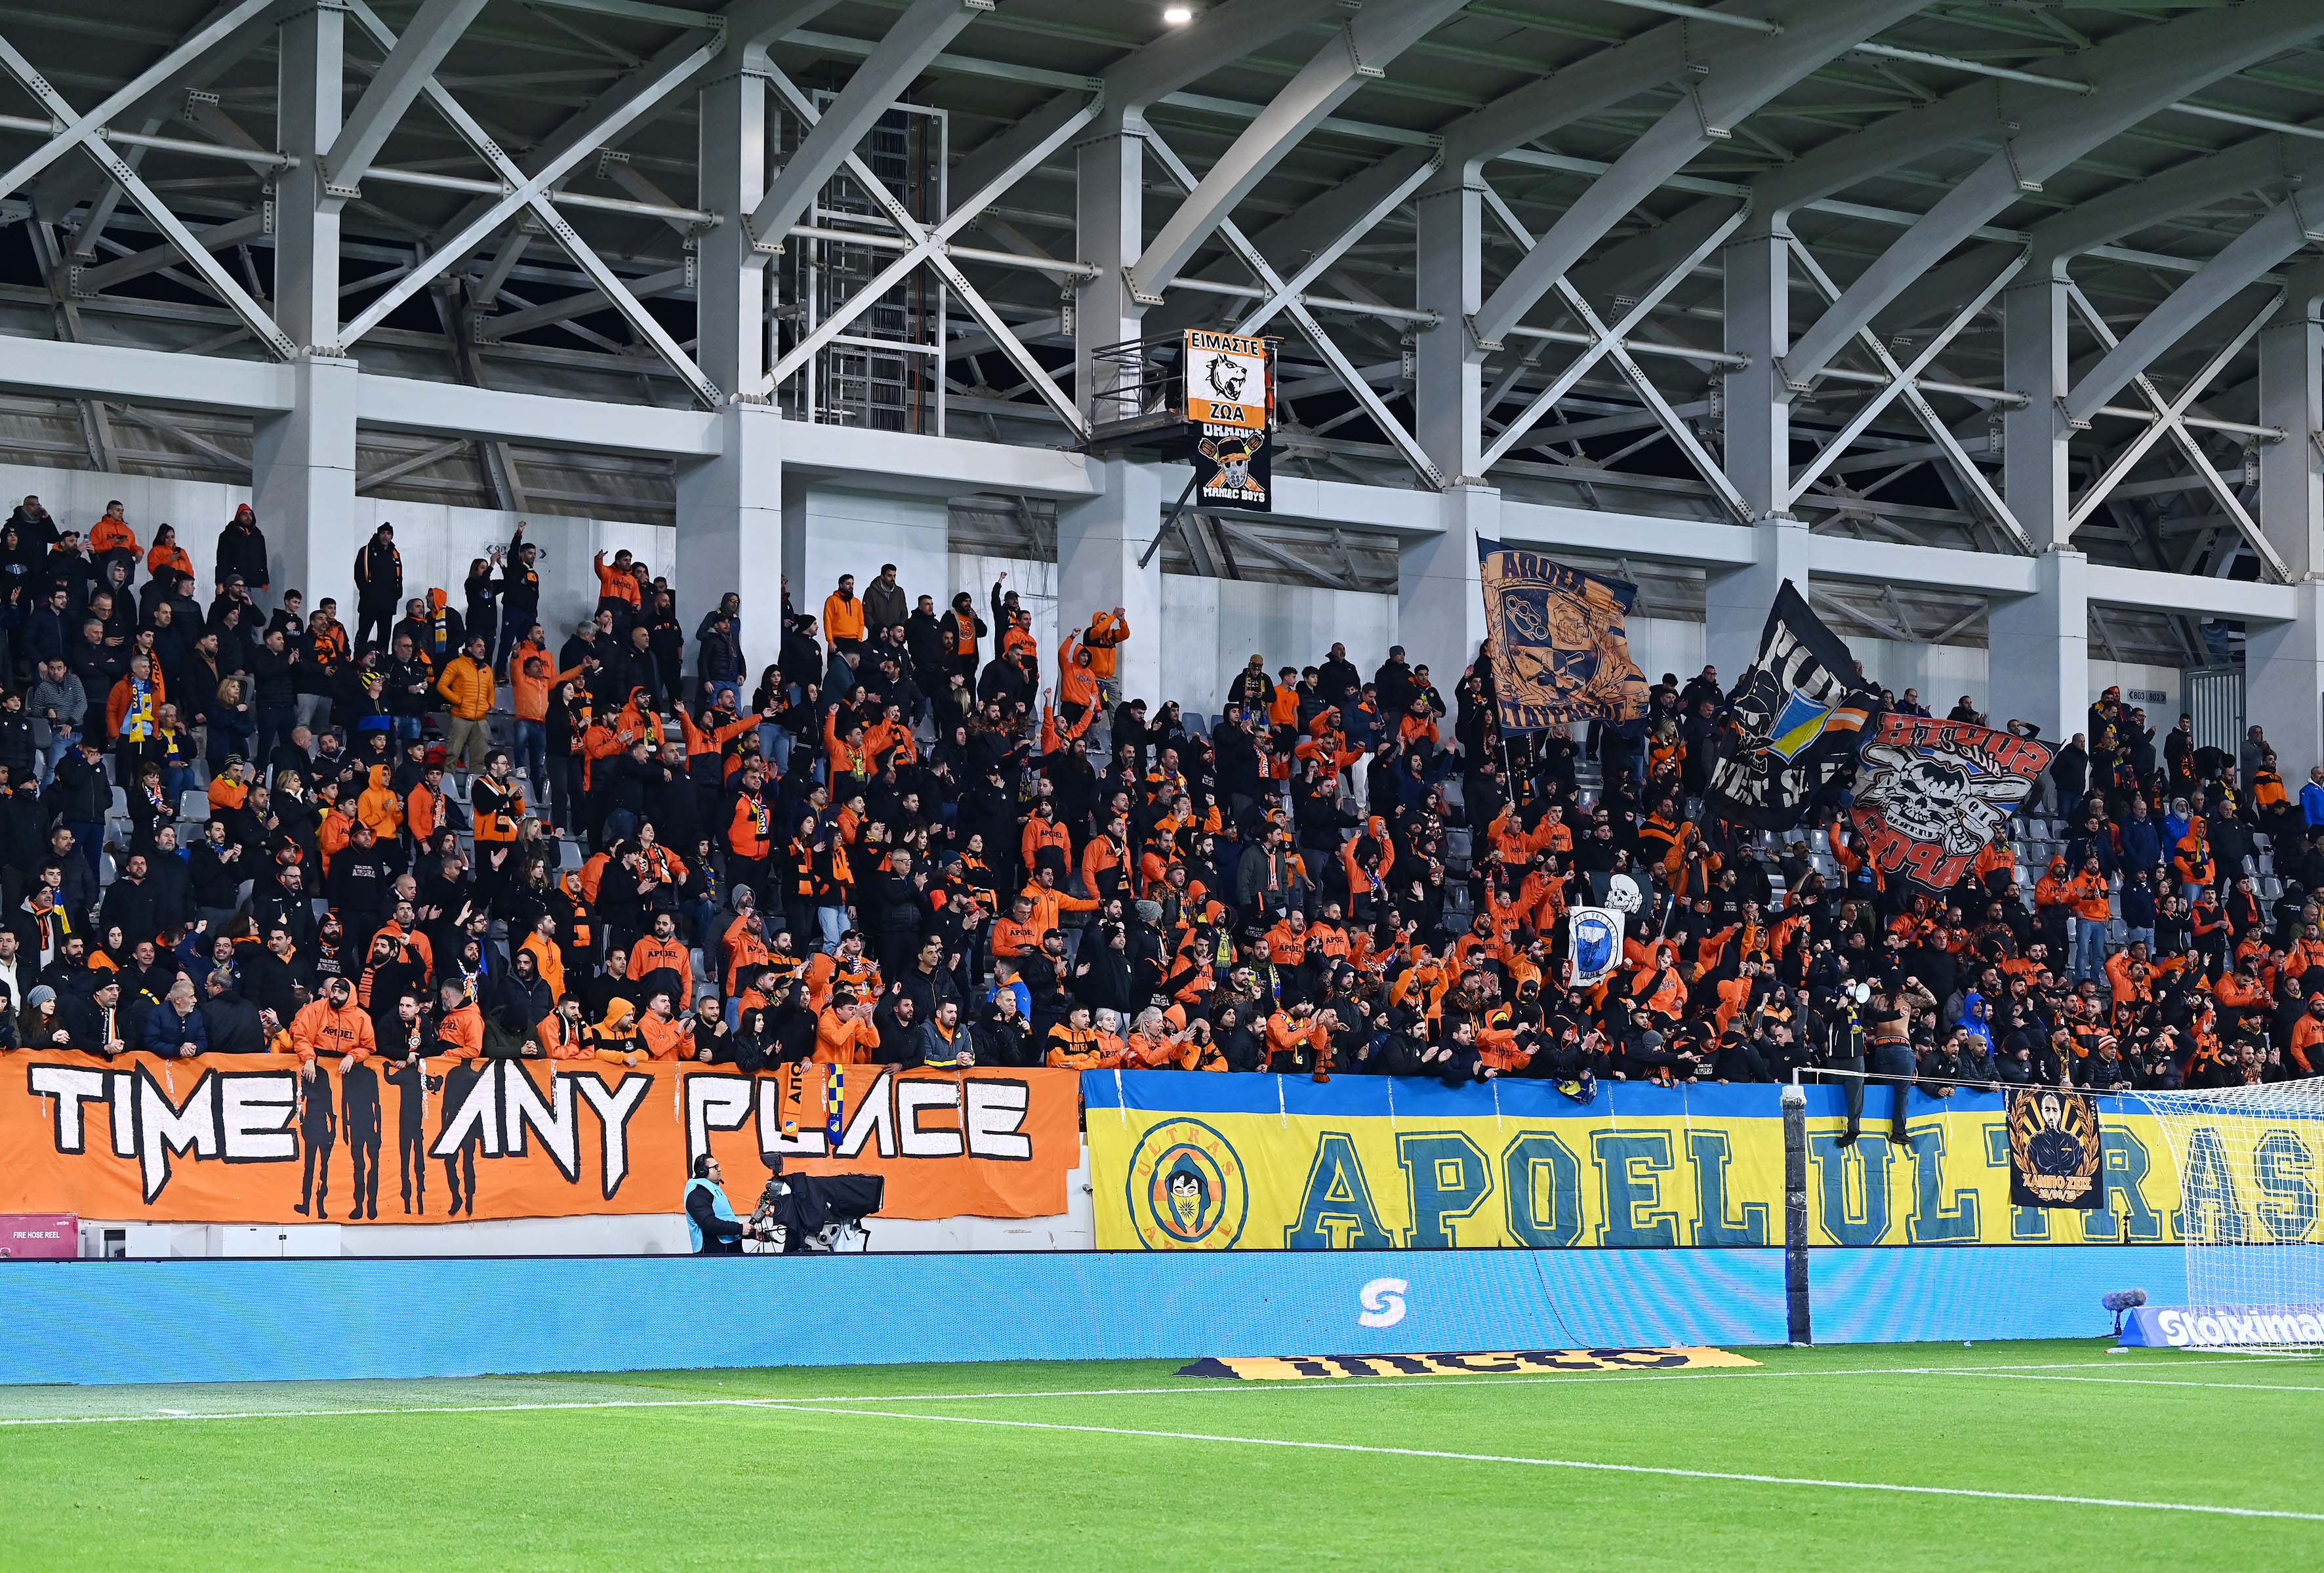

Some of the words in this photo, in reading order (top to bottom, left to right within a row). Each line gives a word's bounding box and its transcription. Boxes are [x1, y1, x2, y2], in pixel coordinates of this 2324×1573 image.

[1191, 331, 1259, 356] ΕΙΜΑΣΤΕ
[1210, 402, 1246, 422] ΖΩΑ
[1203, 487, 1240, 499] MANIAC
[1241, 489, 1266, 503] BOYS
[2134, 690, 2145, 700] 803
[2149, 691, 2160, 701] 802
[1040, 829, 1063, 839] APOEL
[1009, 929, 1035, 937] APOEL
[1325, 936, 1345, 945] APOEL
[647, 949, 678, 959] APOEL
[1278, 945, 1303, 953] APOEL
[322, 1025, 354, 1040] APOEL
[28, 1060, 300, 1205] TIME
[429, 1057, 655, 1201] ANY
[683, 1071, 1032, 1179] PLACE
[1137, 1127, 1234, 1177] ULTRAS
[1284, 1128, 1770, 1247] APOEL
[2023, 1173, 2066, 1189] ΧΑΜΠΟ
